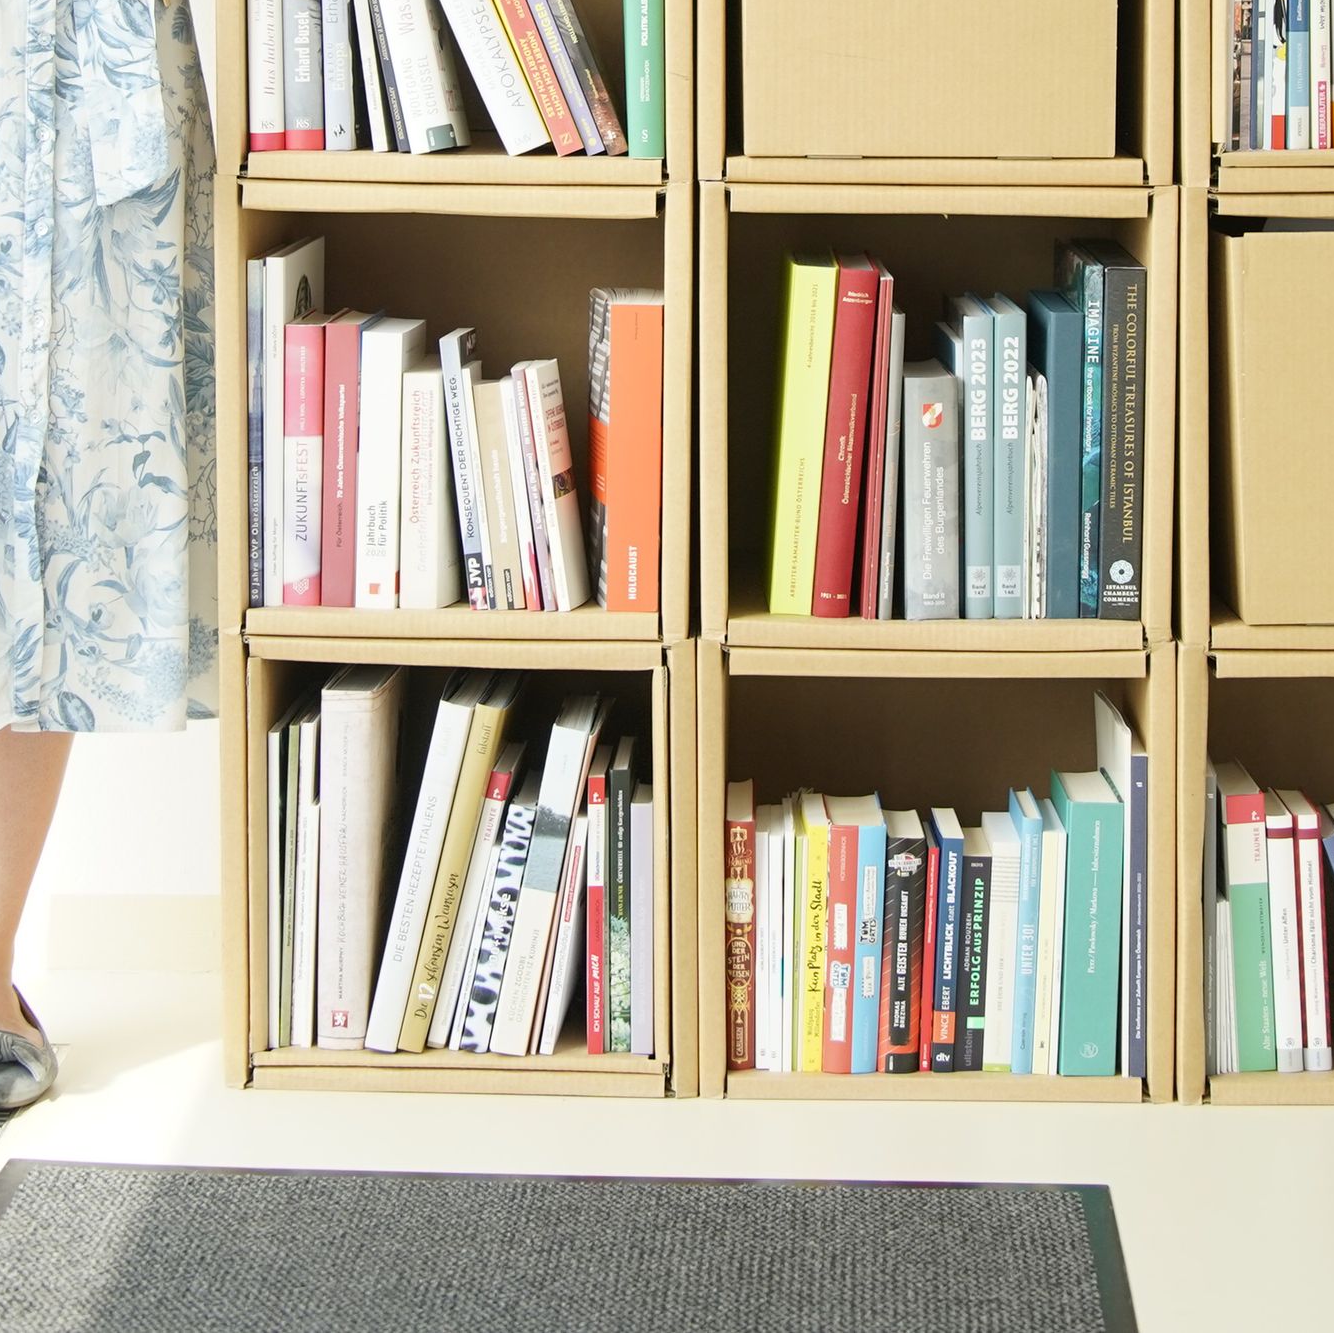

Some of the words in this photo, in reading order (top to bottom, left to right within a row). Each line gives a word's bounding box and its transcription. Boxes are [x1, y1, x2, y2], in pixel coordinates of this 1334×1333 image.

[293, 11, 310, 44] Busek
[395, 0, 415, 35] Was.
[262, 23, 276, 66] haben
[471, 0, 525, 107] APOKALYPSE,
[262, 68, 276, 95] Was
[294, 47, 310, 83] Erhard
[1126, 283, 1138, 310] THE
[1086, 299, 1100, 363] IMAGINE
[1111, 324, 1120, 344] FROM
[1124, 312, 1137, 381] COLORFUL
[971, 338, 987, 386] 2023
[1002, 336, 1019, 384] 2022
[1111, 344, 1120, 382] BYZANTINE
[336, 383, 347, 420] Volkspartei
[1002, 388, 1019, 439] BERG
[1110, 382, 1119, 413] MOSAICS
[410, 389, 422, 465] Zukunftsreich
[451, 402, 465, 447] RICHTIGE
[971, 389, 987, 441] BERG
[1123, 383, 1136, 456] TREASURES
[335, 420, 346, 470] Österreichische
[837, 435, 847, 461] Chronik
[1109, 423, 1118, 459] OTTOMAN
[456, 449, 467, 471] DER
[921, 440, 933, 505] Feuerwehren
[1109, 459, 1117, 490] CERAMIC
[1123, 460, 1134, 479] OF
[295, 439, 309, 542] ZUKUNFTsFEST
[336, 471, 344, 490] Jahre
[973, 442, 985, 516] Alpenvereinsjahrbuch
[1005, 441, 1015, 515] Alpenvereinsjahrbuch
[250, 465, 260, 536] Oberösterreich
[408, 467, 422, 524] Österreich
[459, 472, 476, 539] KONSEQUENT
[934, 465, 947, 534] Burgenlandes
[1108, 490, 1117, 509] TILES
[365, 505, 377, 547] Jahrbuch
[377, 499, 388, 532] Politik
[1083, 512, 1092, 542] Reinhard
[250, 537, 260, 560] ÖVP
[378, 533, 388, 547] für
[921, 506, 934, 561] Freiwilligen
[934, 535, 946, 554] des
[251, 563, 260, 586] Jahre
[468, 557, 483, 587] JVP
[628, 544, 638, 601] HOLOCAUST
[921, 562, 933, 580] Die
[417, 795, 438, 846] ITALIENS
[482, 806, 498, 843] TRAUNER
[1252, 827, 1262, 863] TRAUNER
[406, 848, 428, 895] REZEPTE
[946, 850, 958, 904] BLACKOUT
[727, 888, 751, 900] HARRY
[727, 901, 751, 912] POTTER
[810, 880, 824, 911] Stadt
[972, 877, 985, 930] PRINZIP
[396, 897, 417, 942] BESTEN
[946, 905, 955, 922] statt
[859, 920, 870, 943] TOM
[868, 918, 877, 944] GATES
[972, 931, 983, 954] AUS
[1021, 924, 1035, 942] 30!
[1281, 926, 1289, 945] Unter
[392, 942, 406, 962] DIE
[727, 954, 750, 965] STEIN
[806, 944, 823, 970] Platz
[895, 942, 908, 975] GEISTER
[942, 922, 955, 980] LICHTBLICK
[963, 946, 972, 972] ADRIAN
[1020, 944, 1033, 975] UNTER
[1308, 933, 1318, 965] Charisma
[590, 953, 601, 980] MICH
[807, 971, 820, 993] Kein
[969, 955, 982, 1006] ERFOLG
[416, 982, 437, 1002] 12
[941, 985, 951, 1011] EBERT
[893, 1000, 901, 1028] THOMAS
[899, 1000, 907, 1028] BREZINA
[939, 1013, 950, 1041] VINCE
[964, 1029, 974, 1067] ullstein
